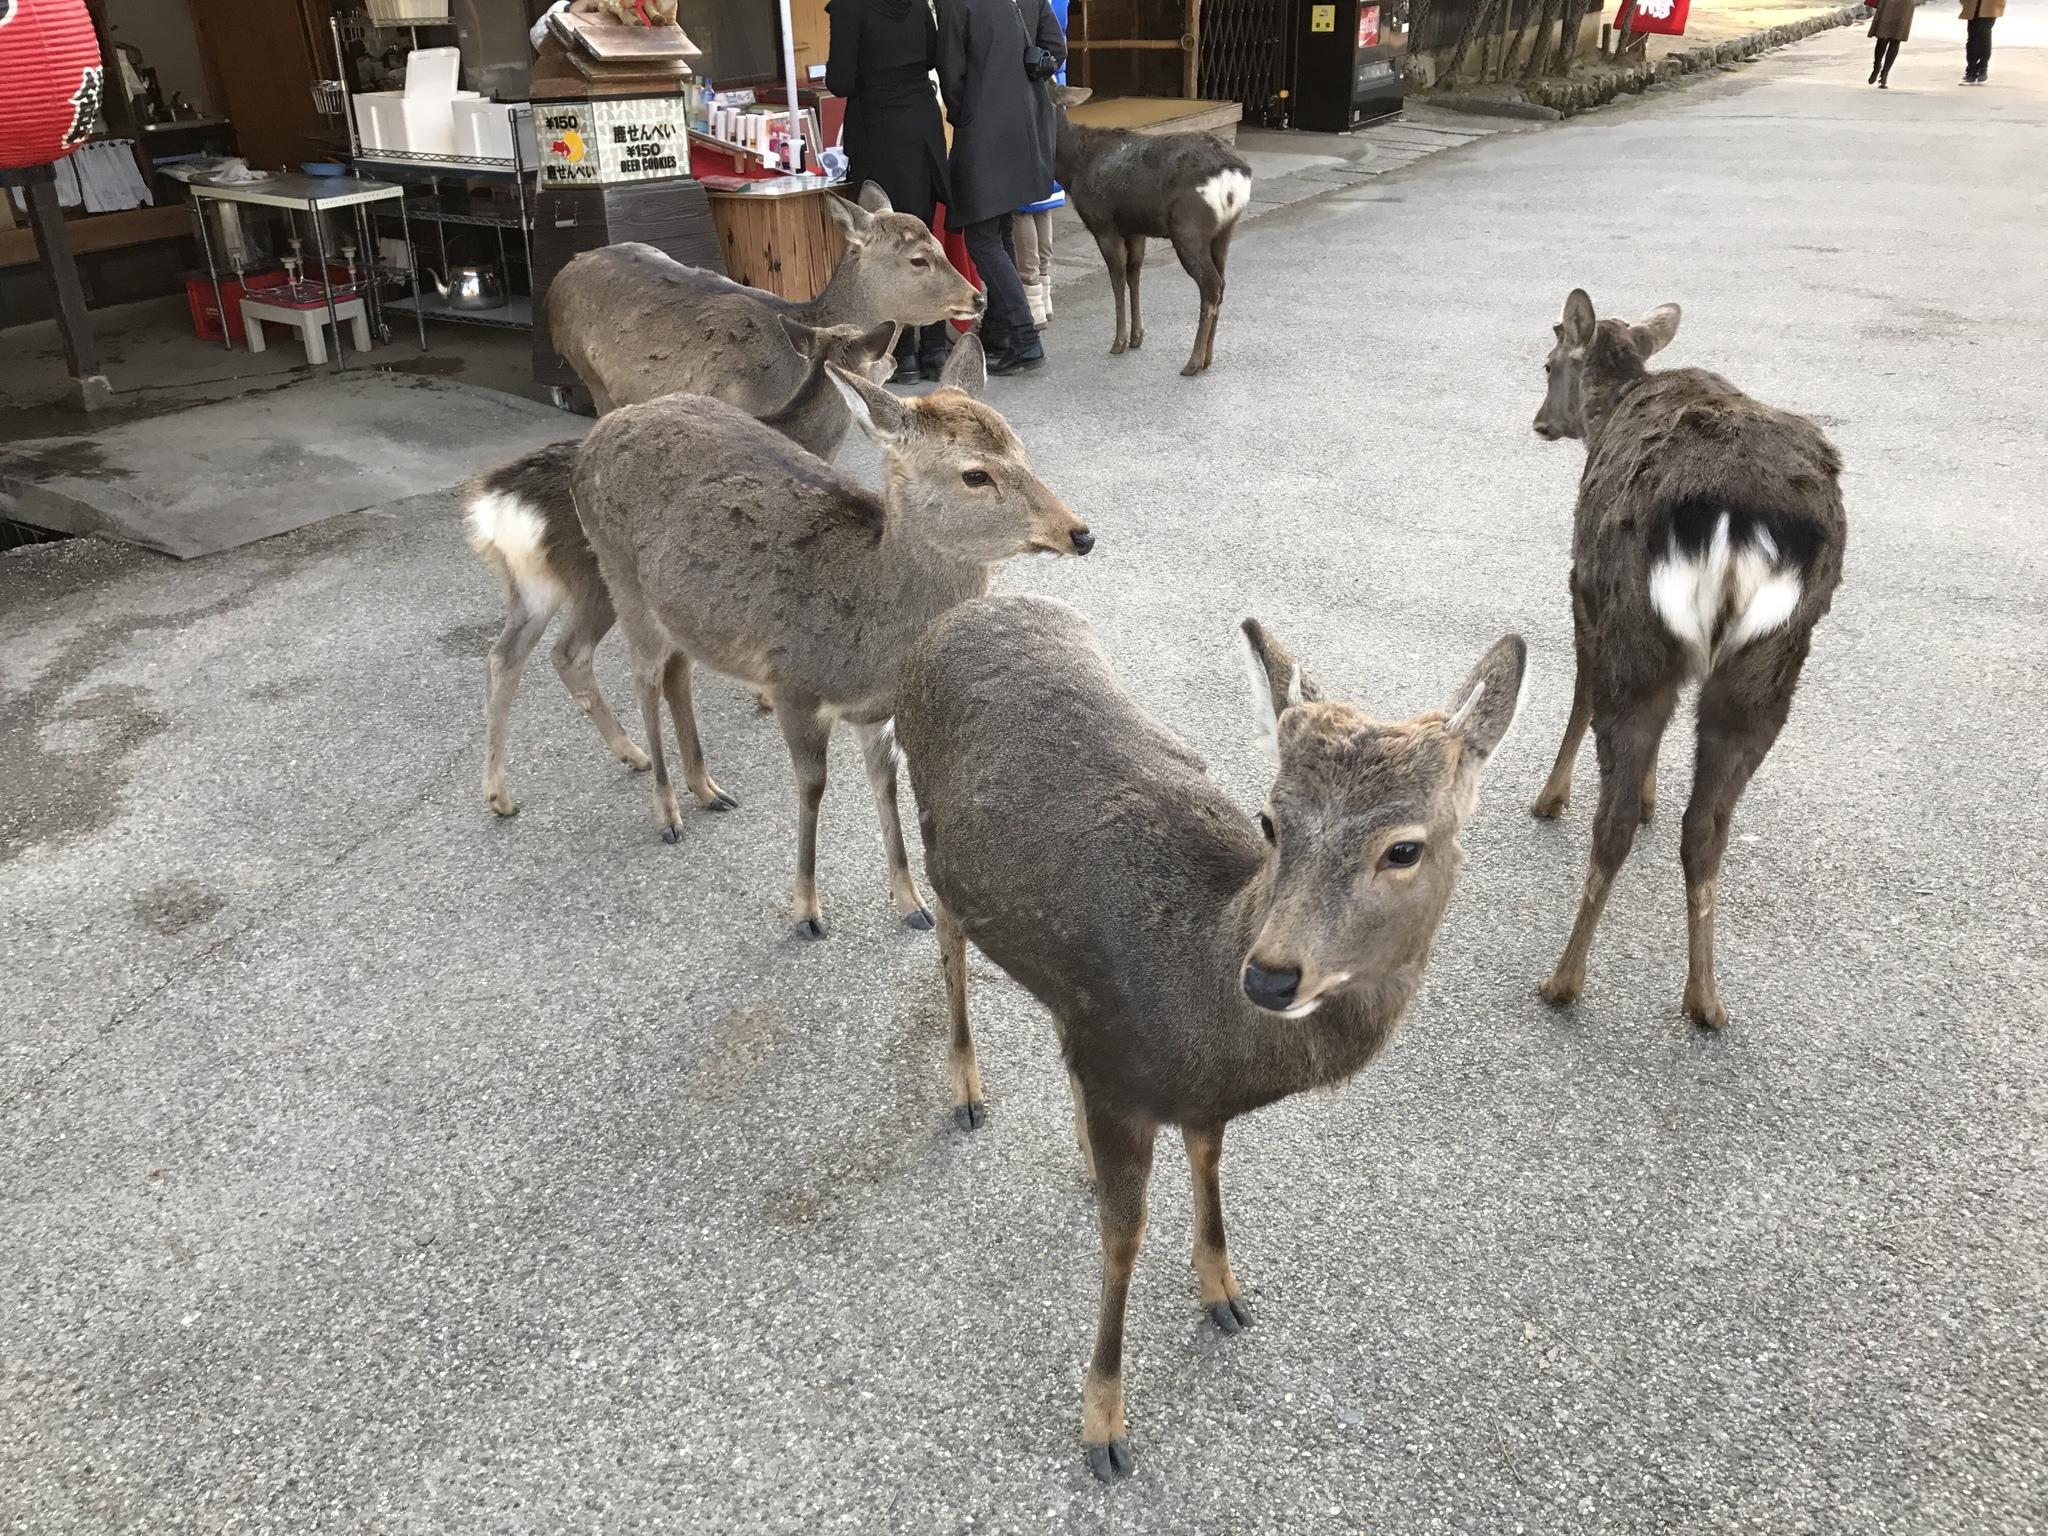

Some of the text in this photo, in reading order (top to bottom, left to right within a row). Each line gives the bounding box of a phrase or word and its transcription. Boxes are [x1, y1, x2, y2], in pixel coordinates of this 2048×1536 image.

[545, 115, 578, 130] ¥150
[613, 124, 676, 144] 鹿せんべい
[626, 143, 661, 158] ¥150
[620, 155, 677, 173] DEER COOKIES
